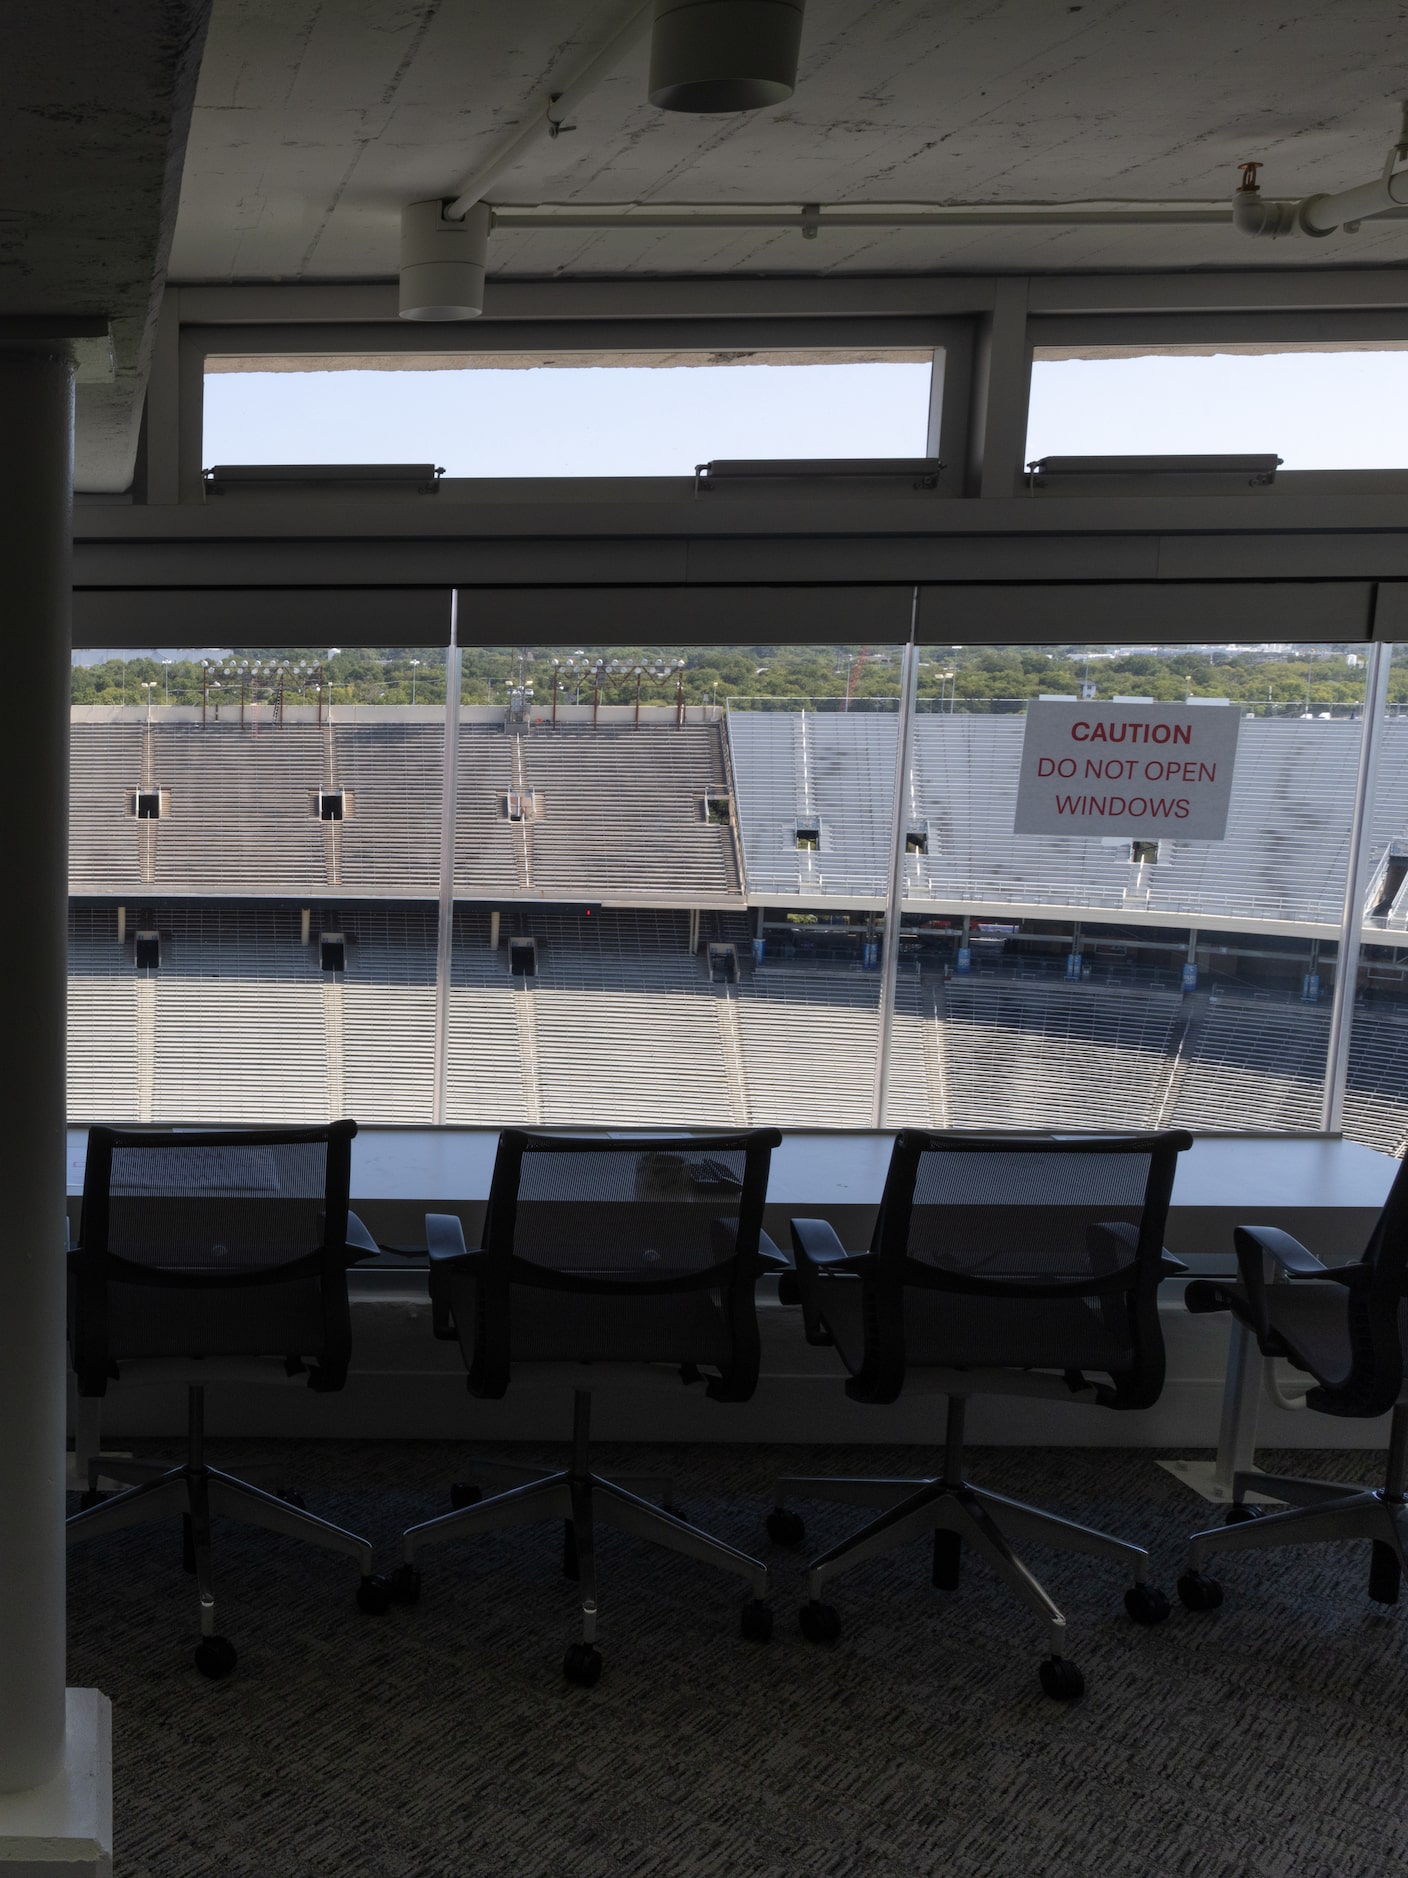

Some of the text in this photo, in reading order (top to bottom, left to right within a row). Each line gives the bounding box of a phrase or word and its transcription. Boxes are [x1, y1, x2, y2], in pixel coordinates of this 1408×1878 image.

[1071, 721, 1192, 745] CAUTION
[1037, 757, 1217, 782] DO NOT OPEN
[1055, 794, 1190, 818] WINDOWS
